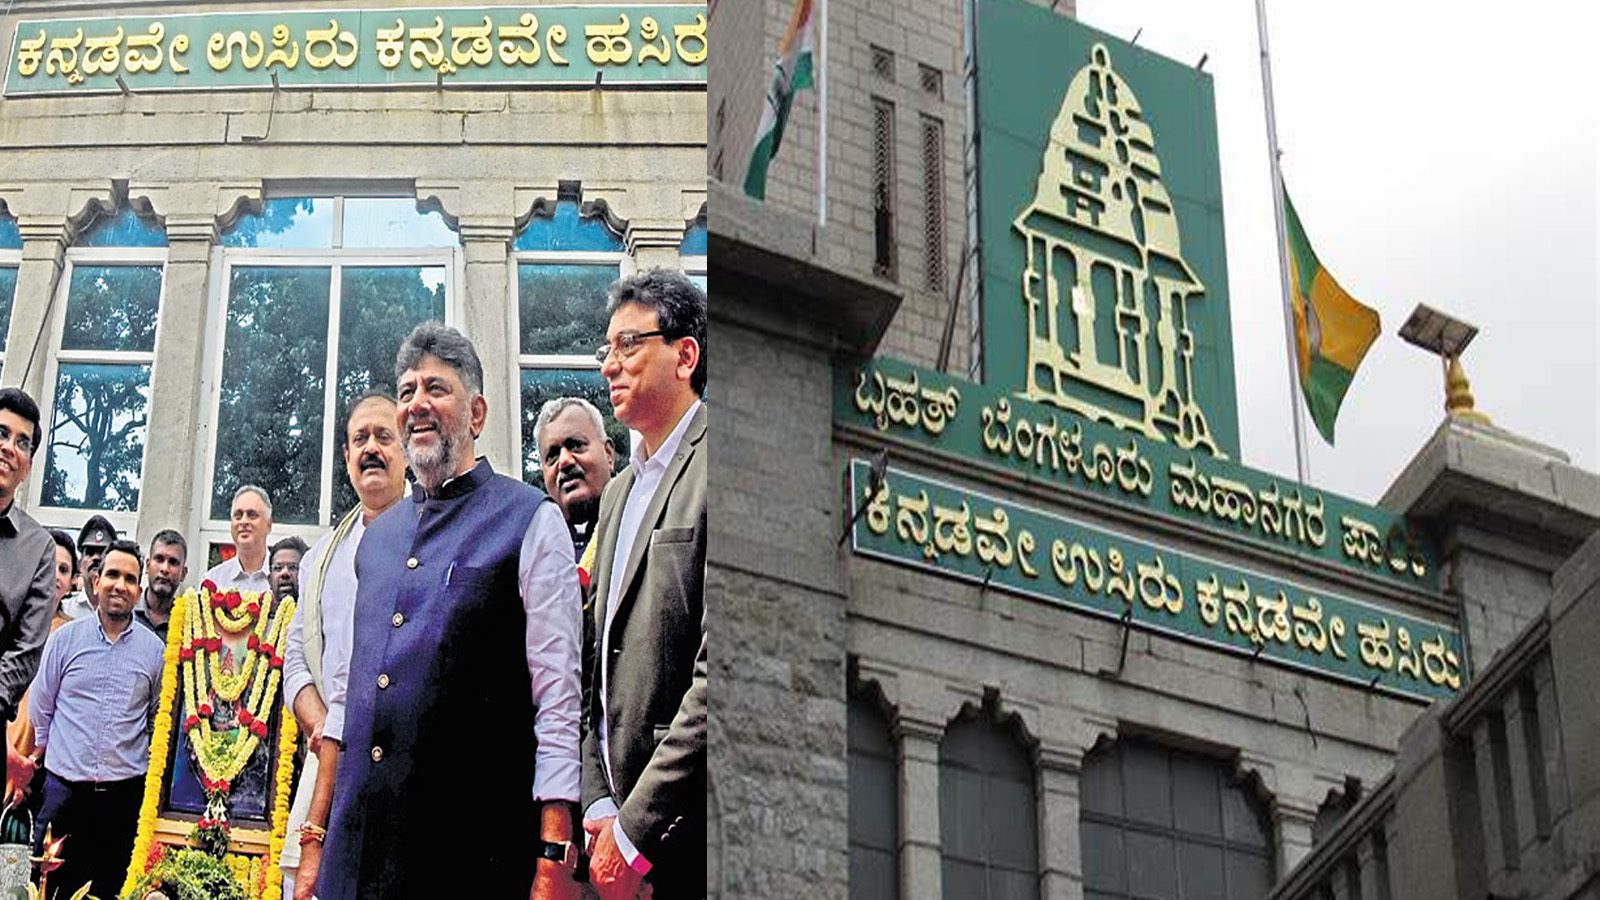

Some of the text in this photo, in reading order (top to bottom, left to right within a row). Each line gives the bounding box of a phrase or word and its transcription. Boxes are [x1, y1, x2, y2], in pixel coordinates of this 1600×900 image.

[17, 22, 190, 84] ಕನ್ನಡವೇ
[206, 19, 359, 71] ಉಸಿರು
[376, 13, 569, 74] ಕನ್ನಡವೇ
[854, 369, 960, 433] ಬೃಹತ್
[982, 397, 1153, 495] ಬೆಂಗಳೂರು
[1169, 456, 1326, 546] ಮಹಾನಗರ
[864, 479, 1461, 689] ಕನ್ನಡವೇ ಉಸಿರು ಕನ್ನಡವೇ ಹಸಿರು
